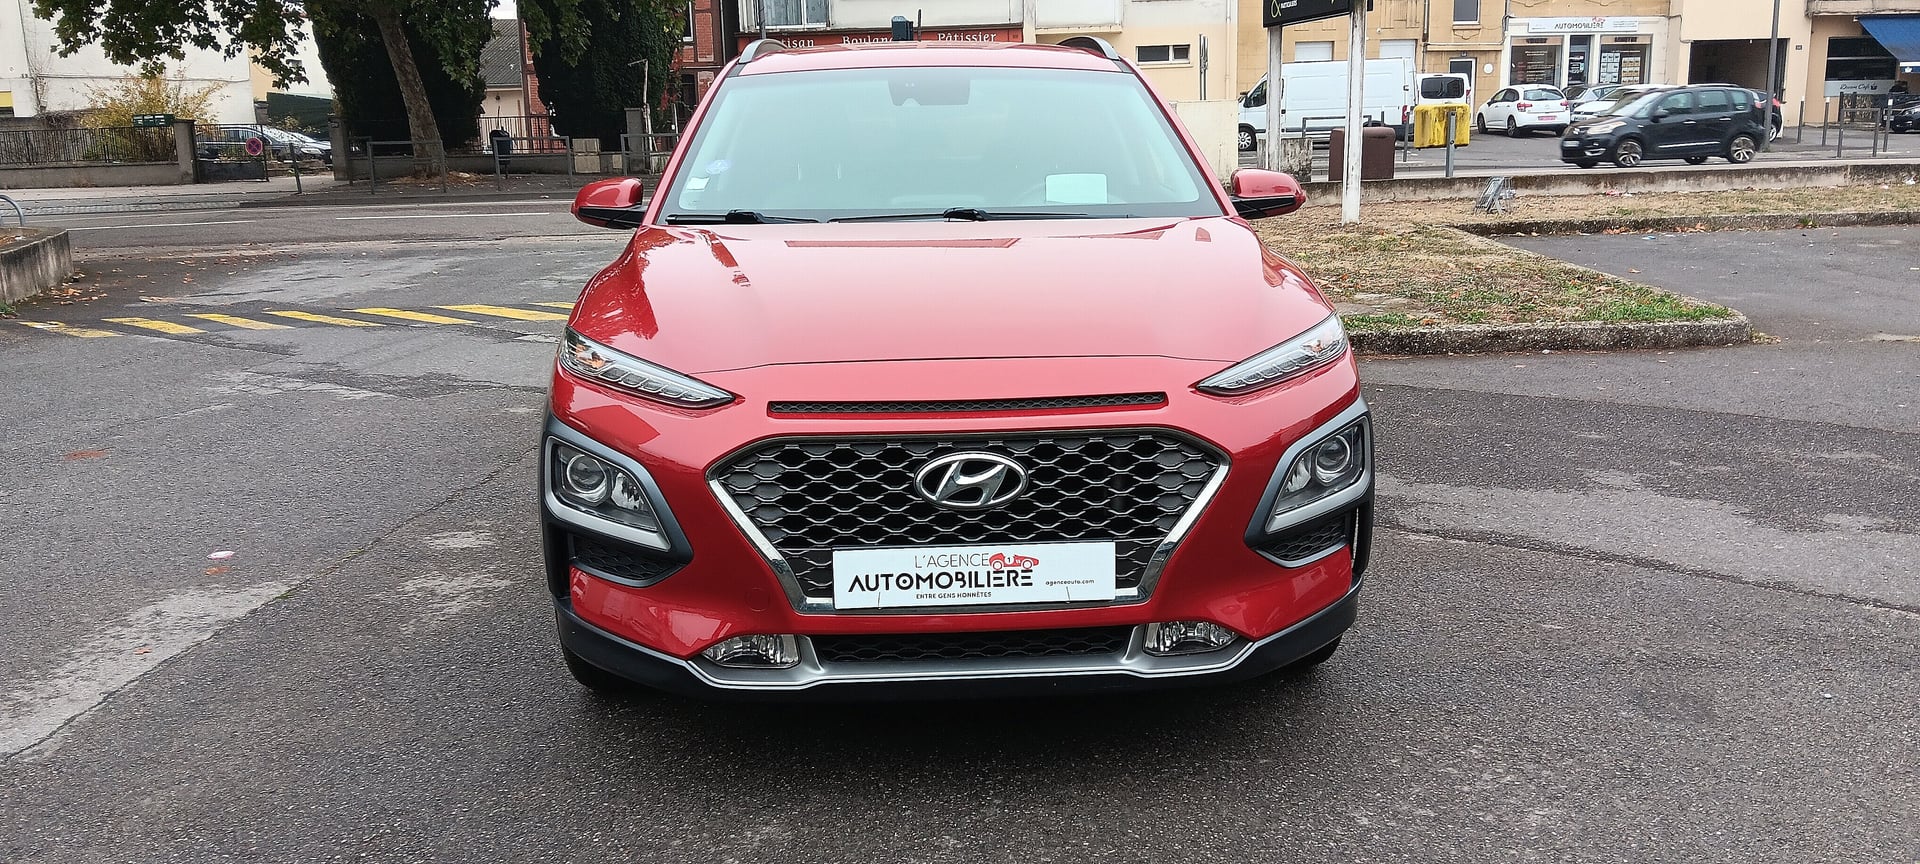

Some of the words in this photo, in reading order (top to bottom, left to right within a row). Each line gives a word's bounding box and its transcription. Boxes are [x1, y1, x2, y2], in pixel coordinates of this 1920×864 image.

[781, 37, 814, 48] tisan
[937, 31, 997, 42] Pâtissier
[914, 553, 990, 569] L'AGENCE
[1045, 578, 1095, 587] agenceauto.com
